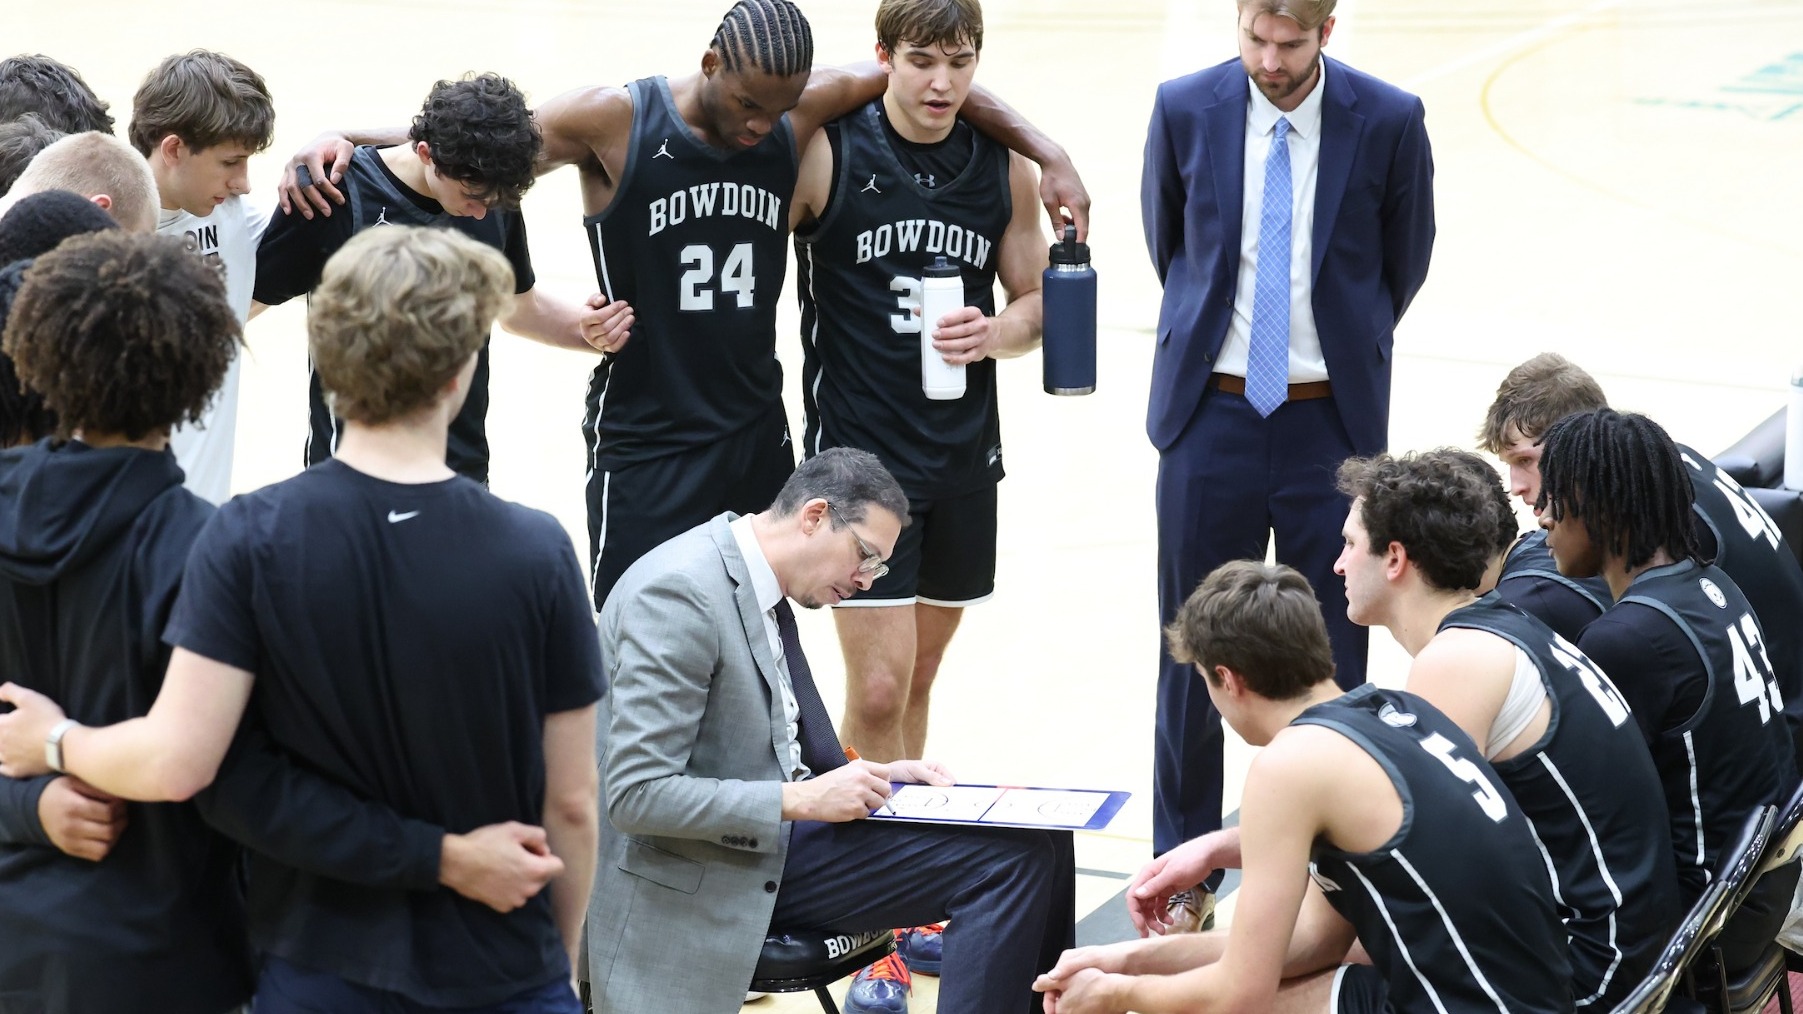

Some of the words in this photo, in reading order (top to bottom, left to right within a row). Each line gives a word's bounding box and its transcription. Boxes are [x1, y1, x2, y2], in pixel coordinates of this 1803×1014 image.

[648, 181, 781, 237] BOWDOIN
[856, 219, 992, 270] BOWDOIN
[679, 242, 756, 311] 24
[1419, 731, 1508, 824] 5
